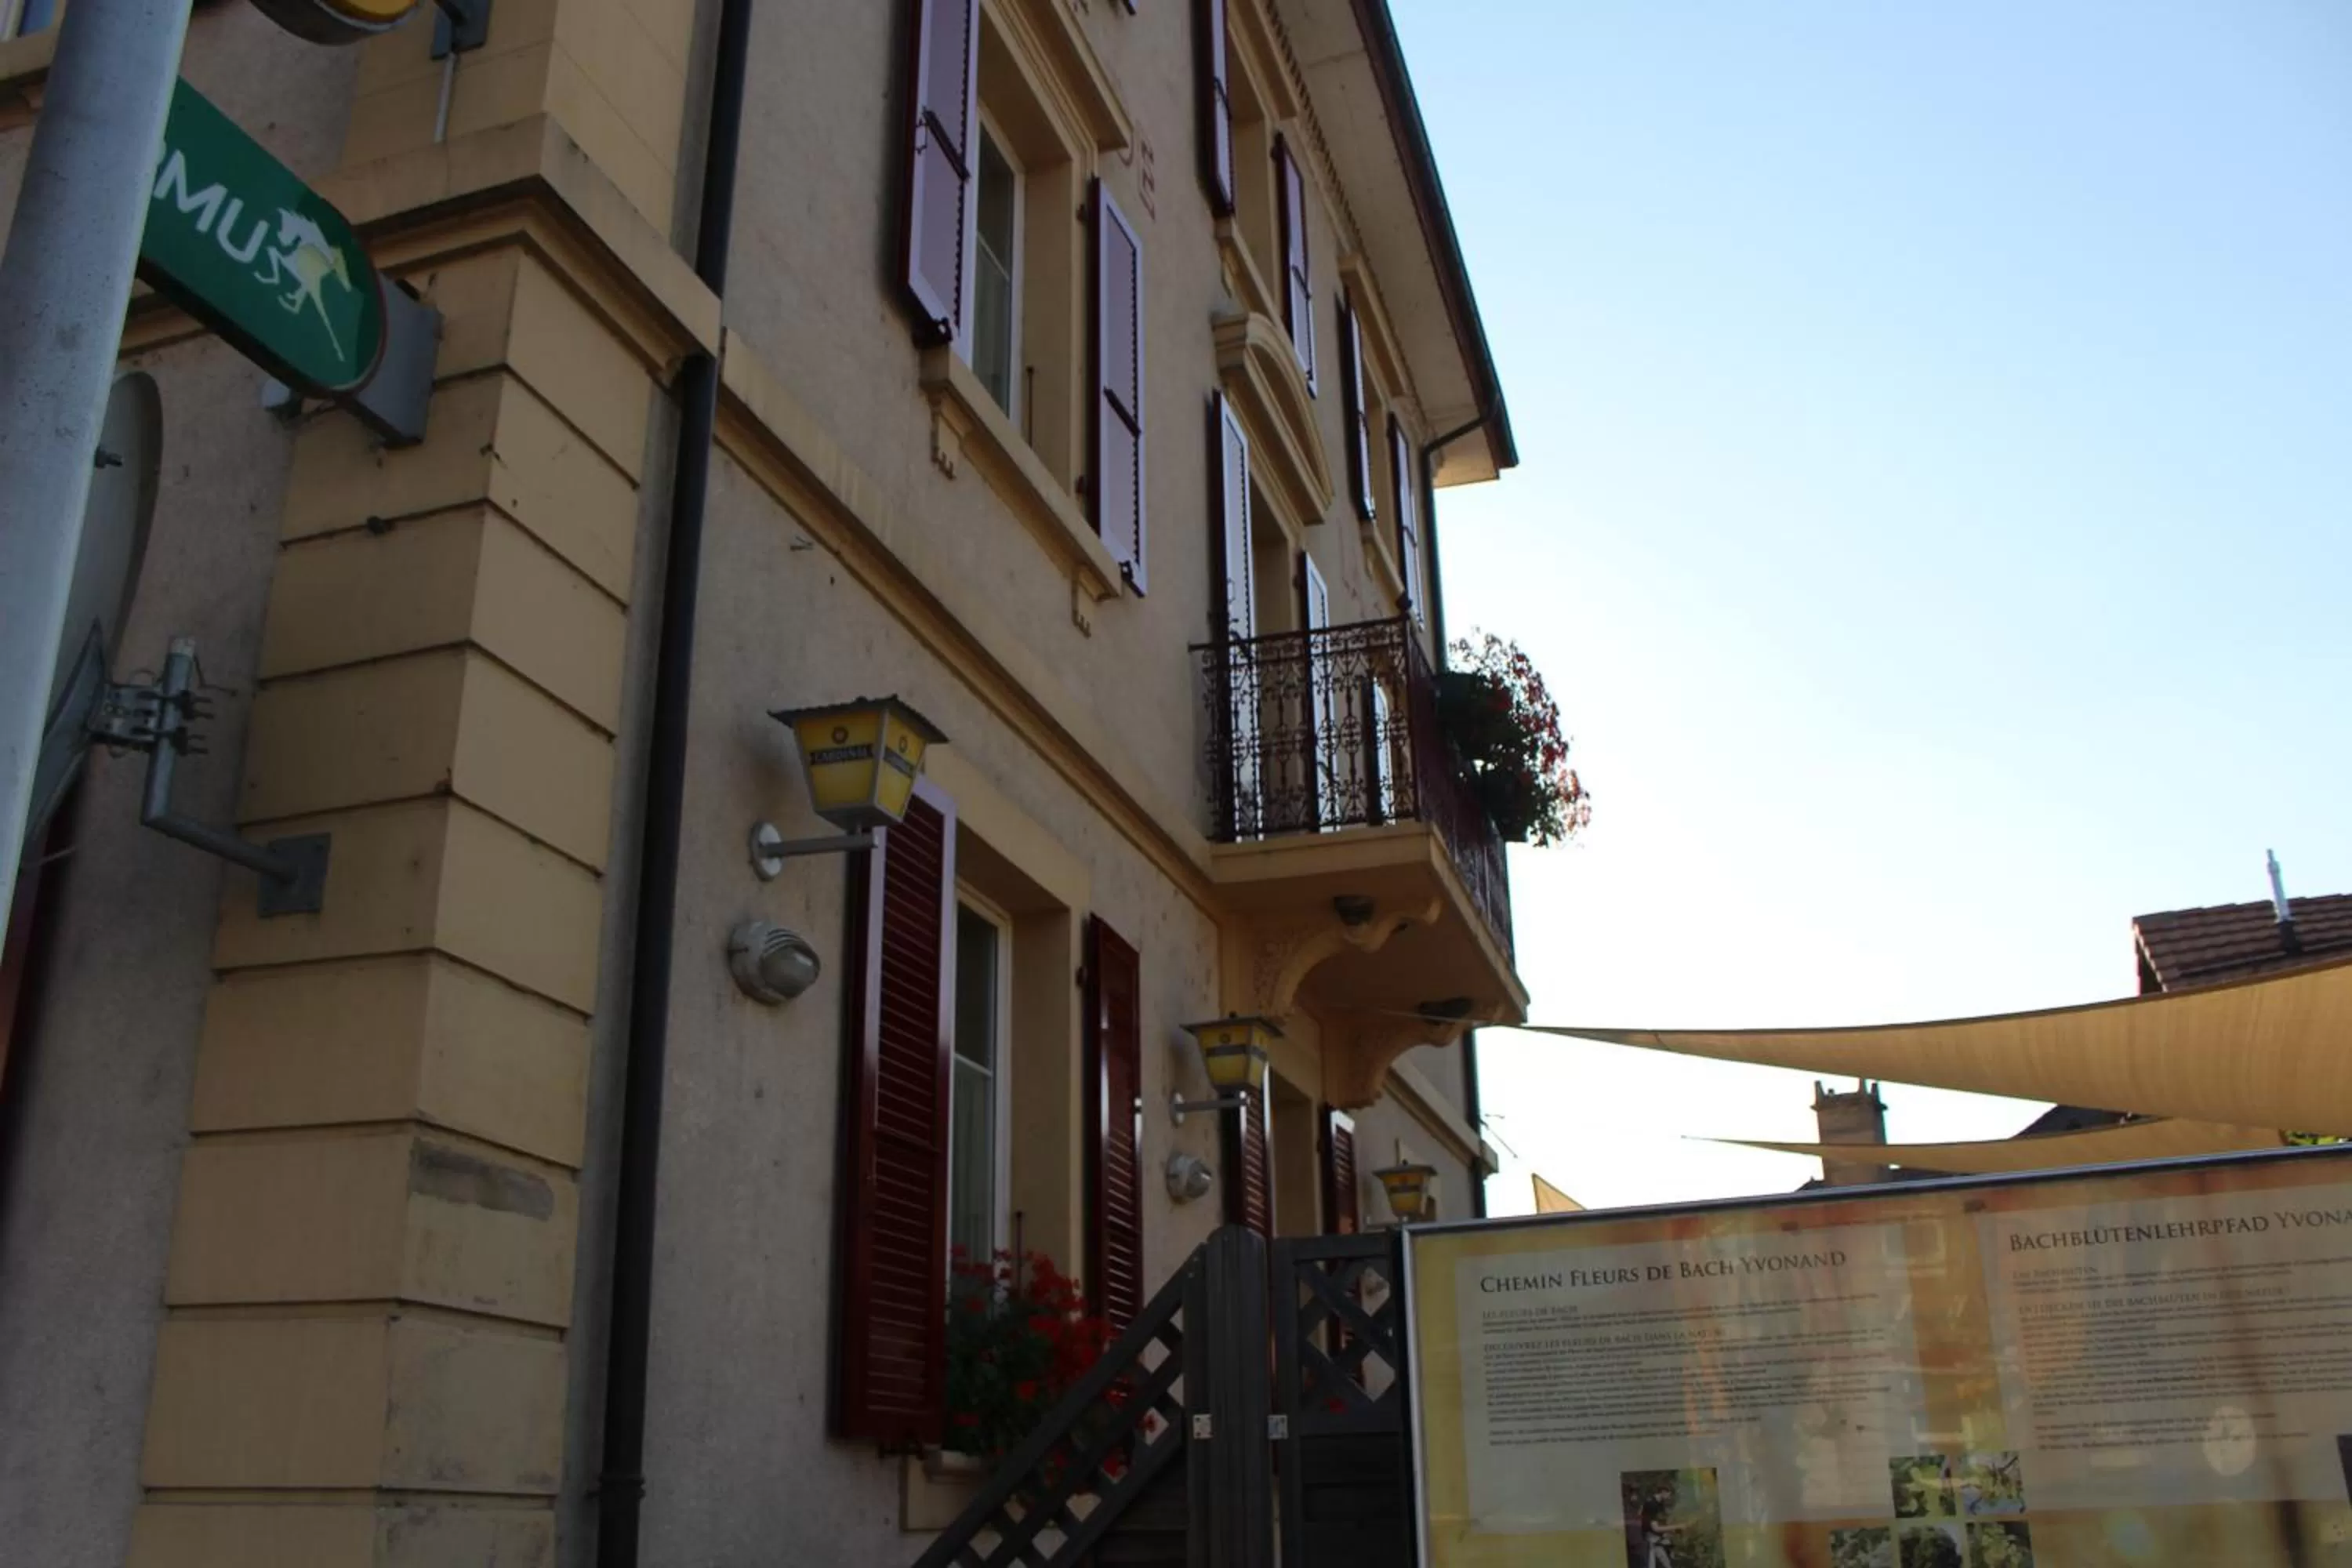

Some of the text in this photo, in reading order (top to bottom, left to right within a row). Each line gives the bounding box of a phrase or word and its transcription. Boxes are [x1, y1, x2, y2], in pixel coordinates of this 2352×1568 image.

[1480, 1250, 1847, 1293] CHEMIN FLEURS DE BACH YVONAND
